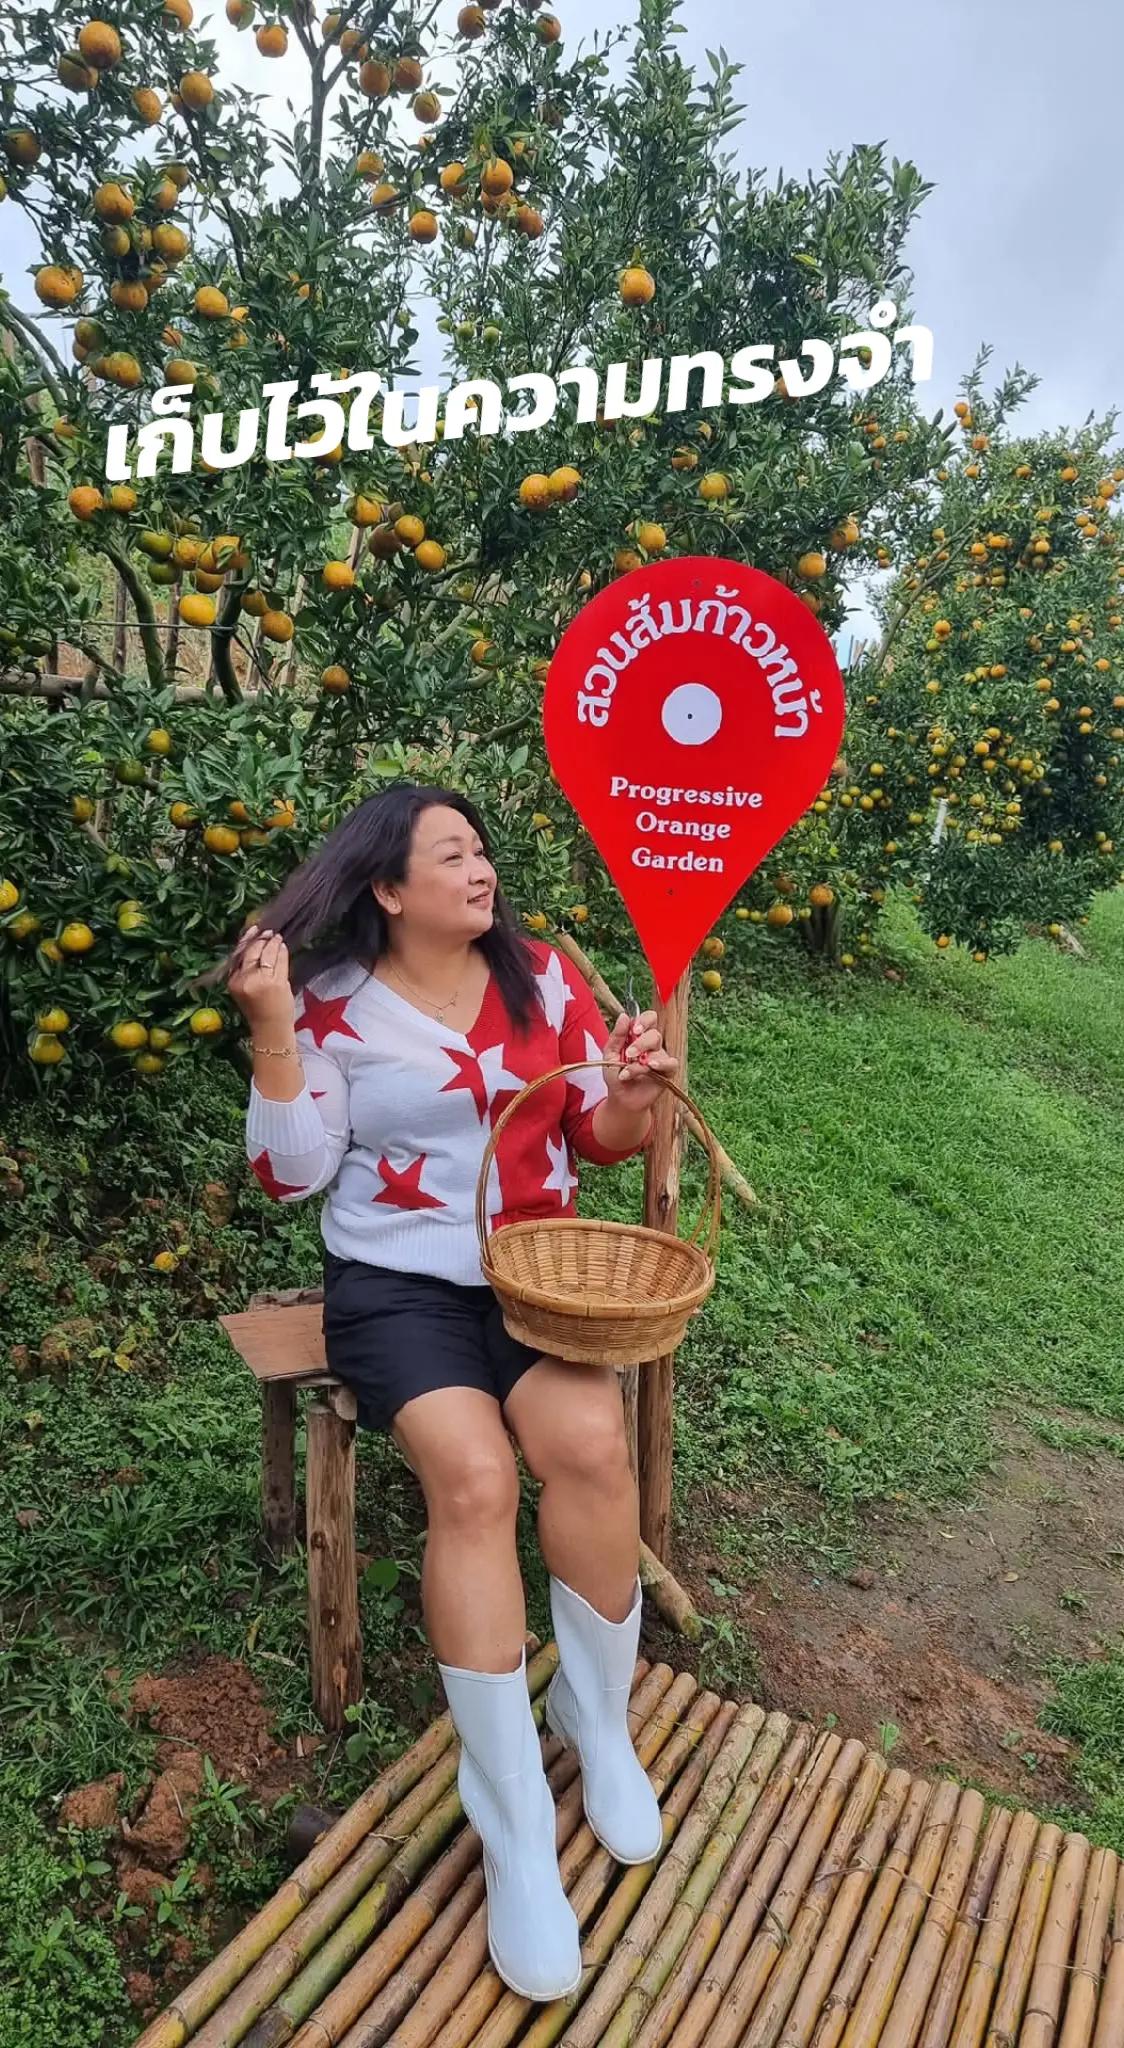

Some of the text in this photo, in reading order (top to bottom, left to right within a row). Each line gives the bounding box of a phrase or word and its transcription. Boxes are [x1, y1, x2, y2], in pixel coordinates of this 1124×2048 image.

[577, 584, 824, 738] สวนส้มก้าวหน้า
[609, 776, 764, 808] Progressive
[635, 811, 732, 842] Orange
[631, 846, 725, 873] Garden
